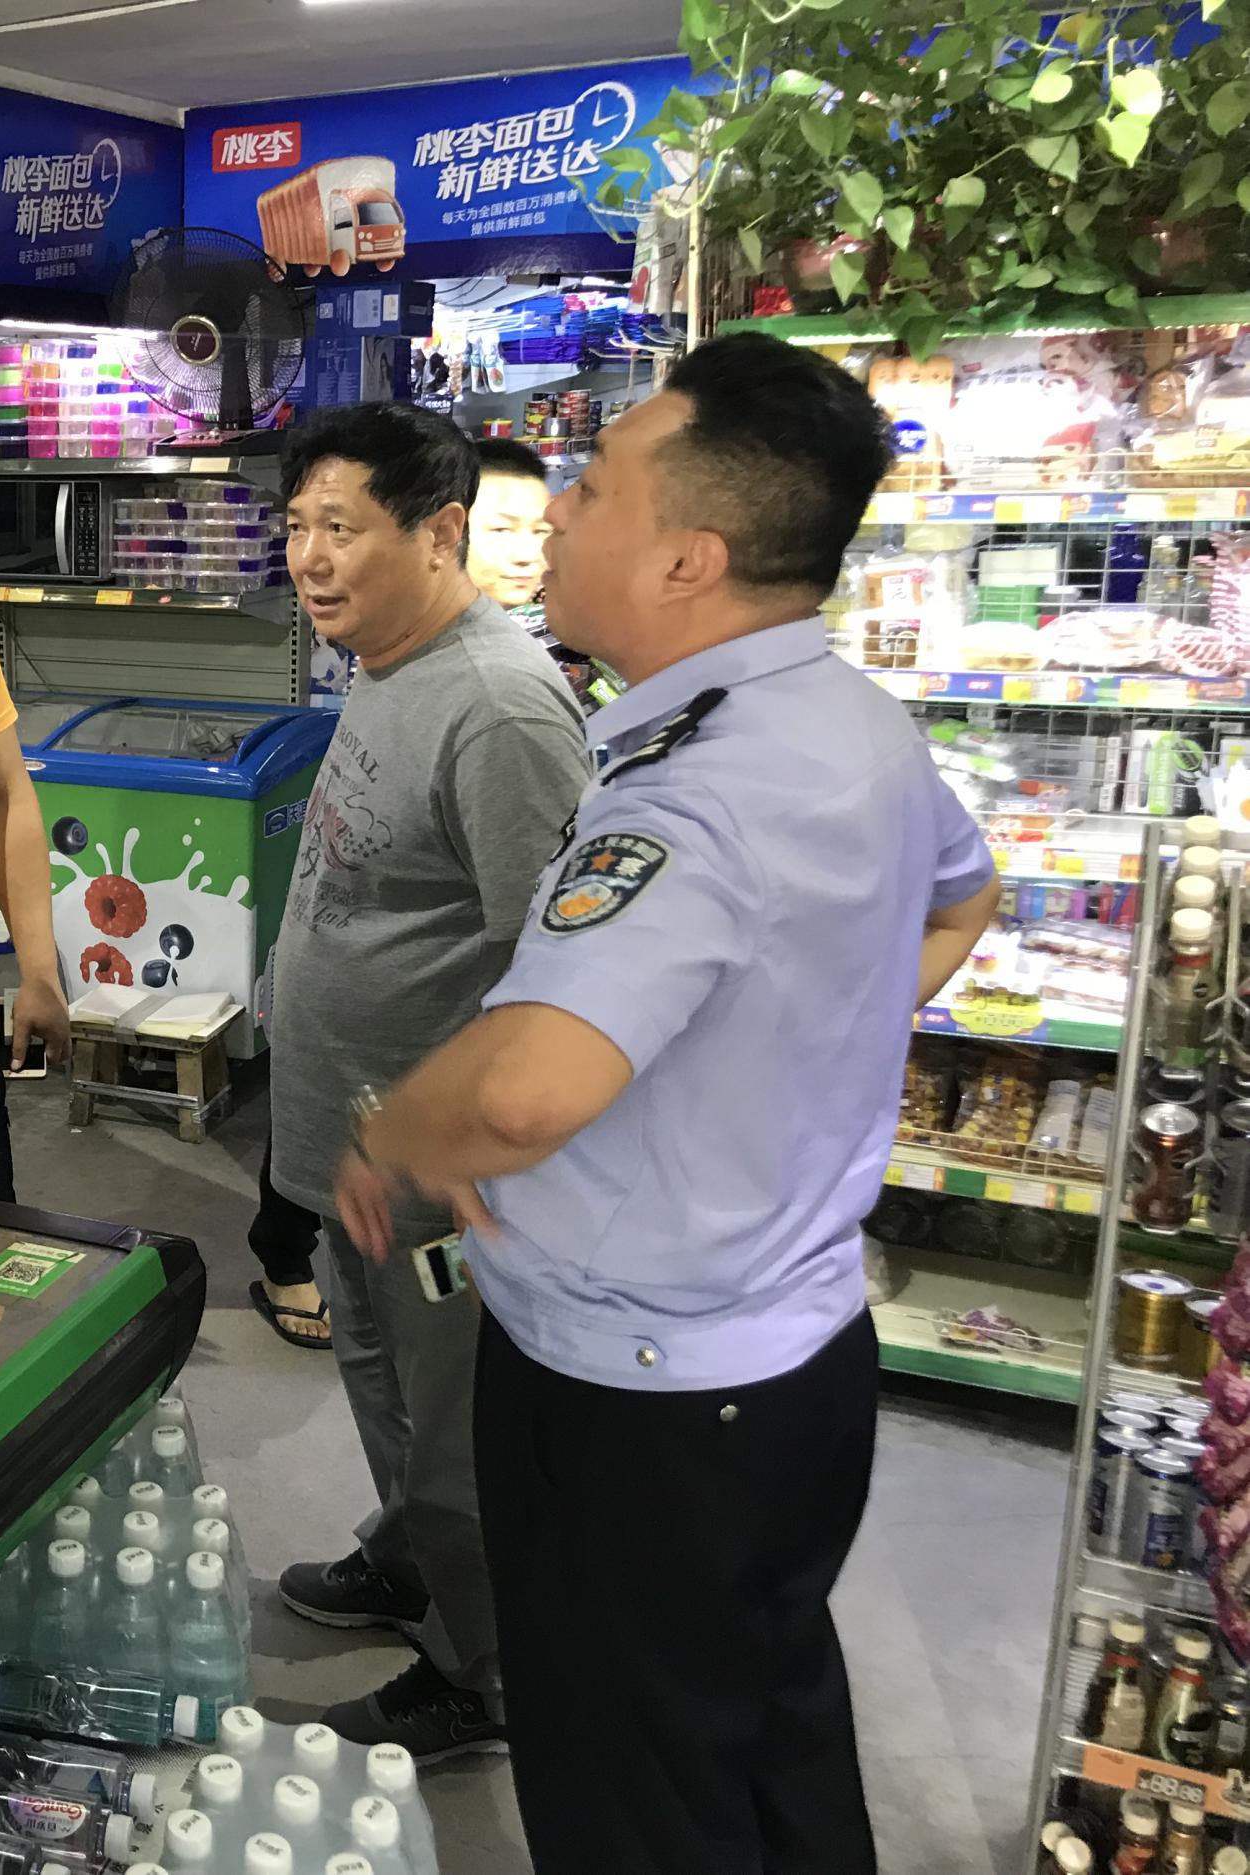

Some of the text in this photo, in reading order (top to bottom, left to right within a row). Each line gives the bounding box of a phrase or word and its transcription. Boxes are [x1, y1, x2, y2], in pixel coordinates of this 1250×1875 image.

[219, 130, 295, 166] 桃李
[412, 103, 576, 169] 桃李面包
[0, 153, 94, 194] 桃李面包
[436, 139, 602, 204] 新鲜送达
[14, 194, 105, 244] 新鲜送达
[441, 189, 579, 225] 每天为全国数百万消费者
[470, 211, 546, 237] 提供新鲜面包
